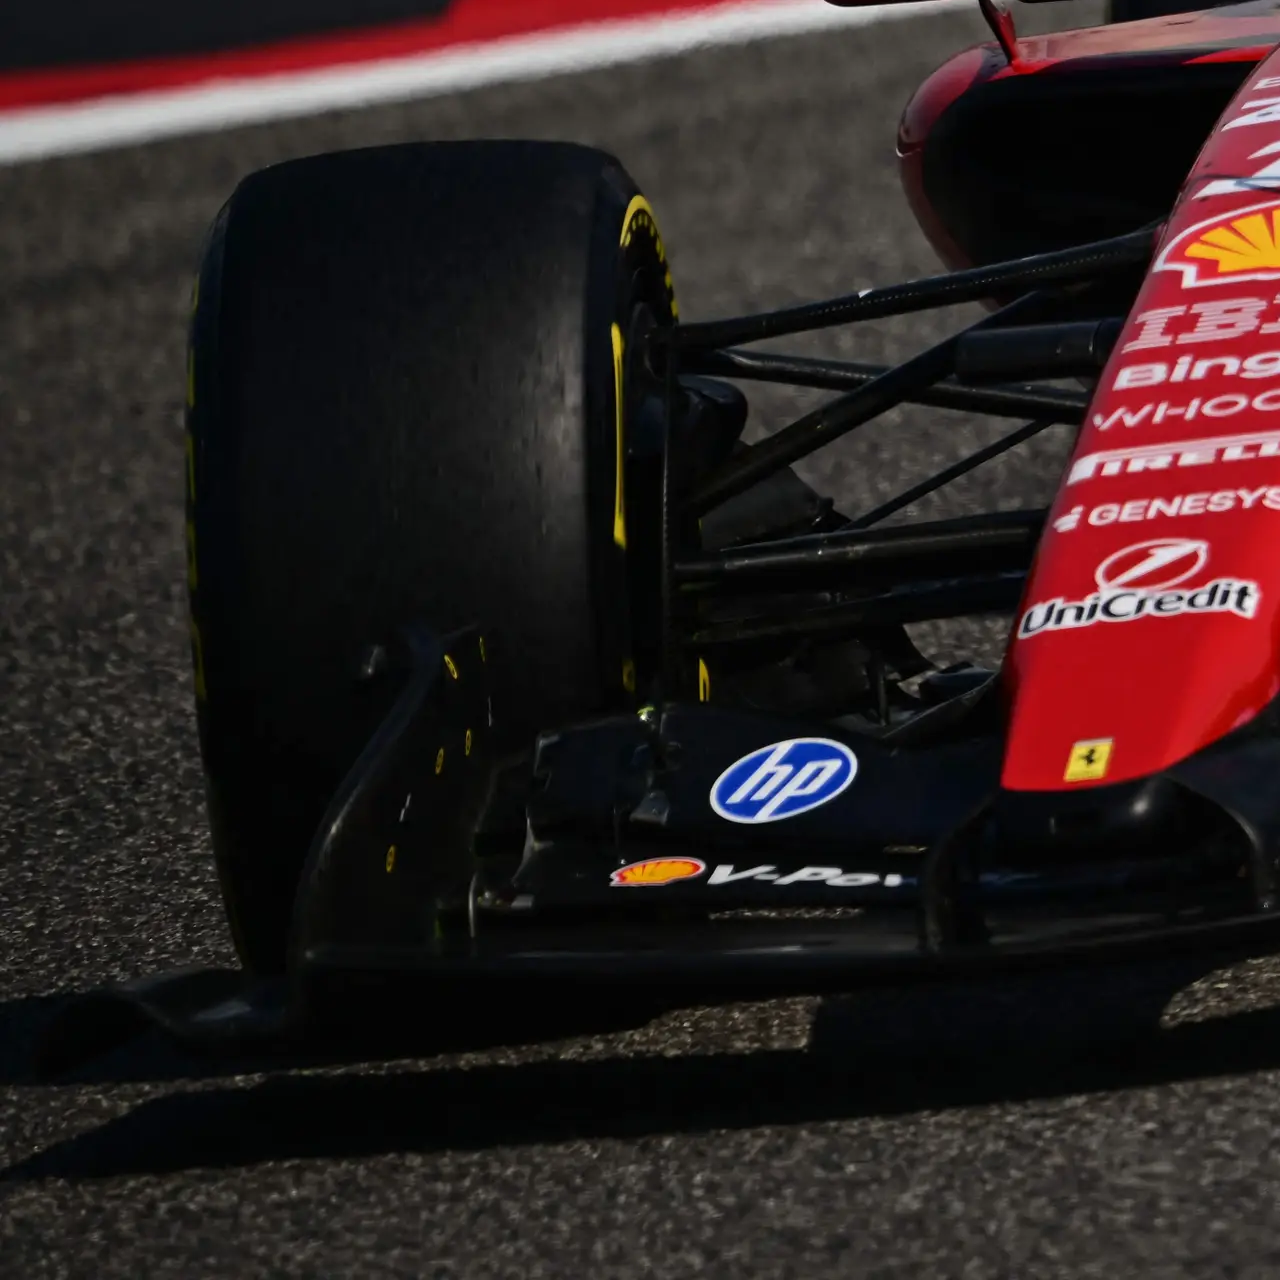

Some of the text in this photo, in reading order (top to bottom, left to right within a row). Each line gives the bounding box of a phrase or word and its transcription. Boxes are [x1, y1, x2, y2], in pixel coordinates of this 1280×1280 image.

[1019, 578, 1261, 638] UniCredit
[720, 739, 847, 821] hp
[706, 864, 918, 887] V-Po
